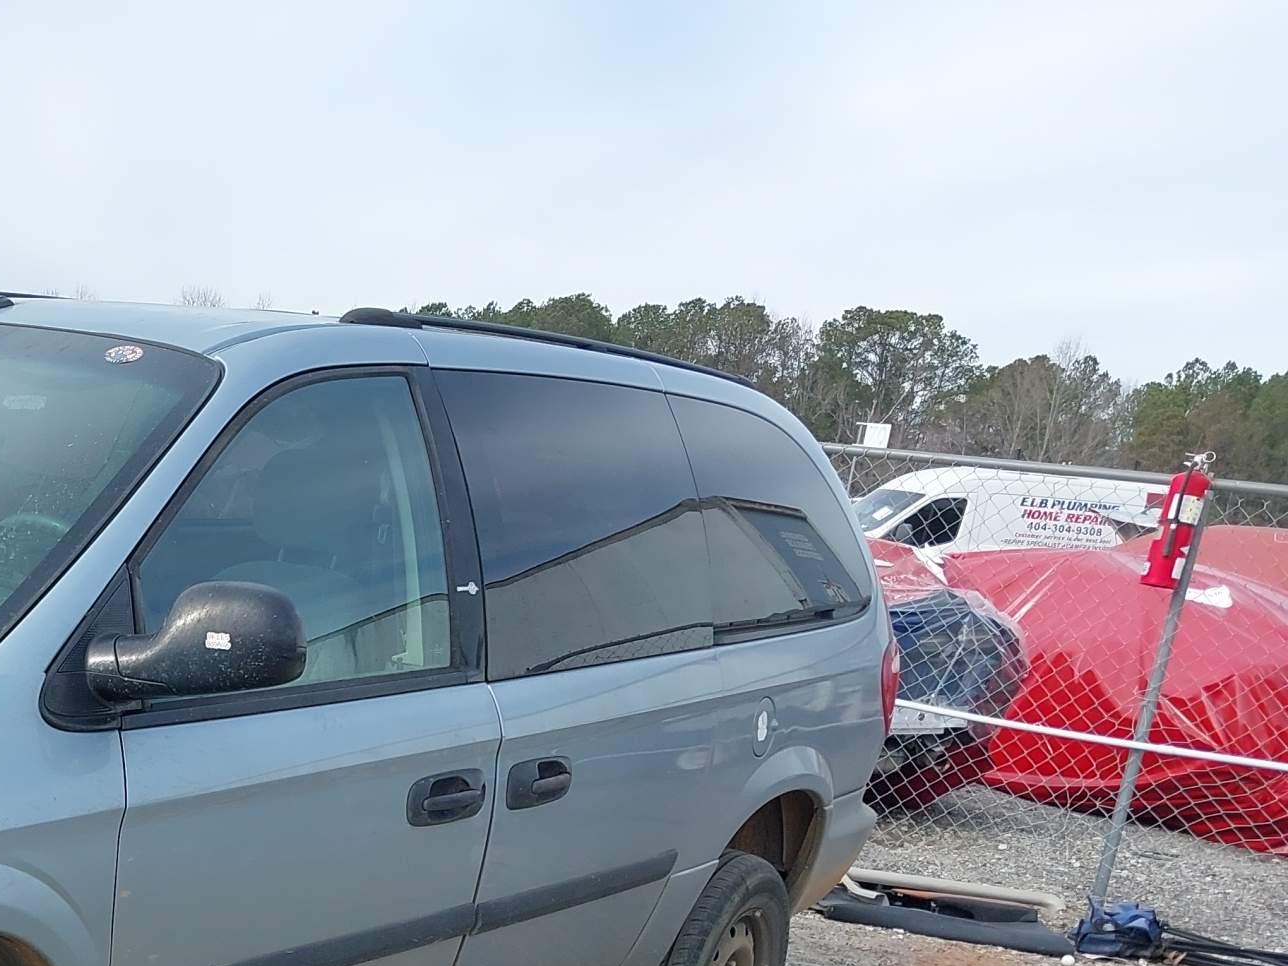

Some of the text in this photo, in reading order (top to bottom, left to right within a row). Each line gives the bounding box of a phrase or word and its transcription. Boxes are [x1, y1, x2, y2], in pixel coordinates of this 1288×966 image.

[1020, 497, 1049, 508] ELB
[1021, 509, 1111, 526] HOME REPAIR
[1027, 522, 1102, 536] 404-304-9308
